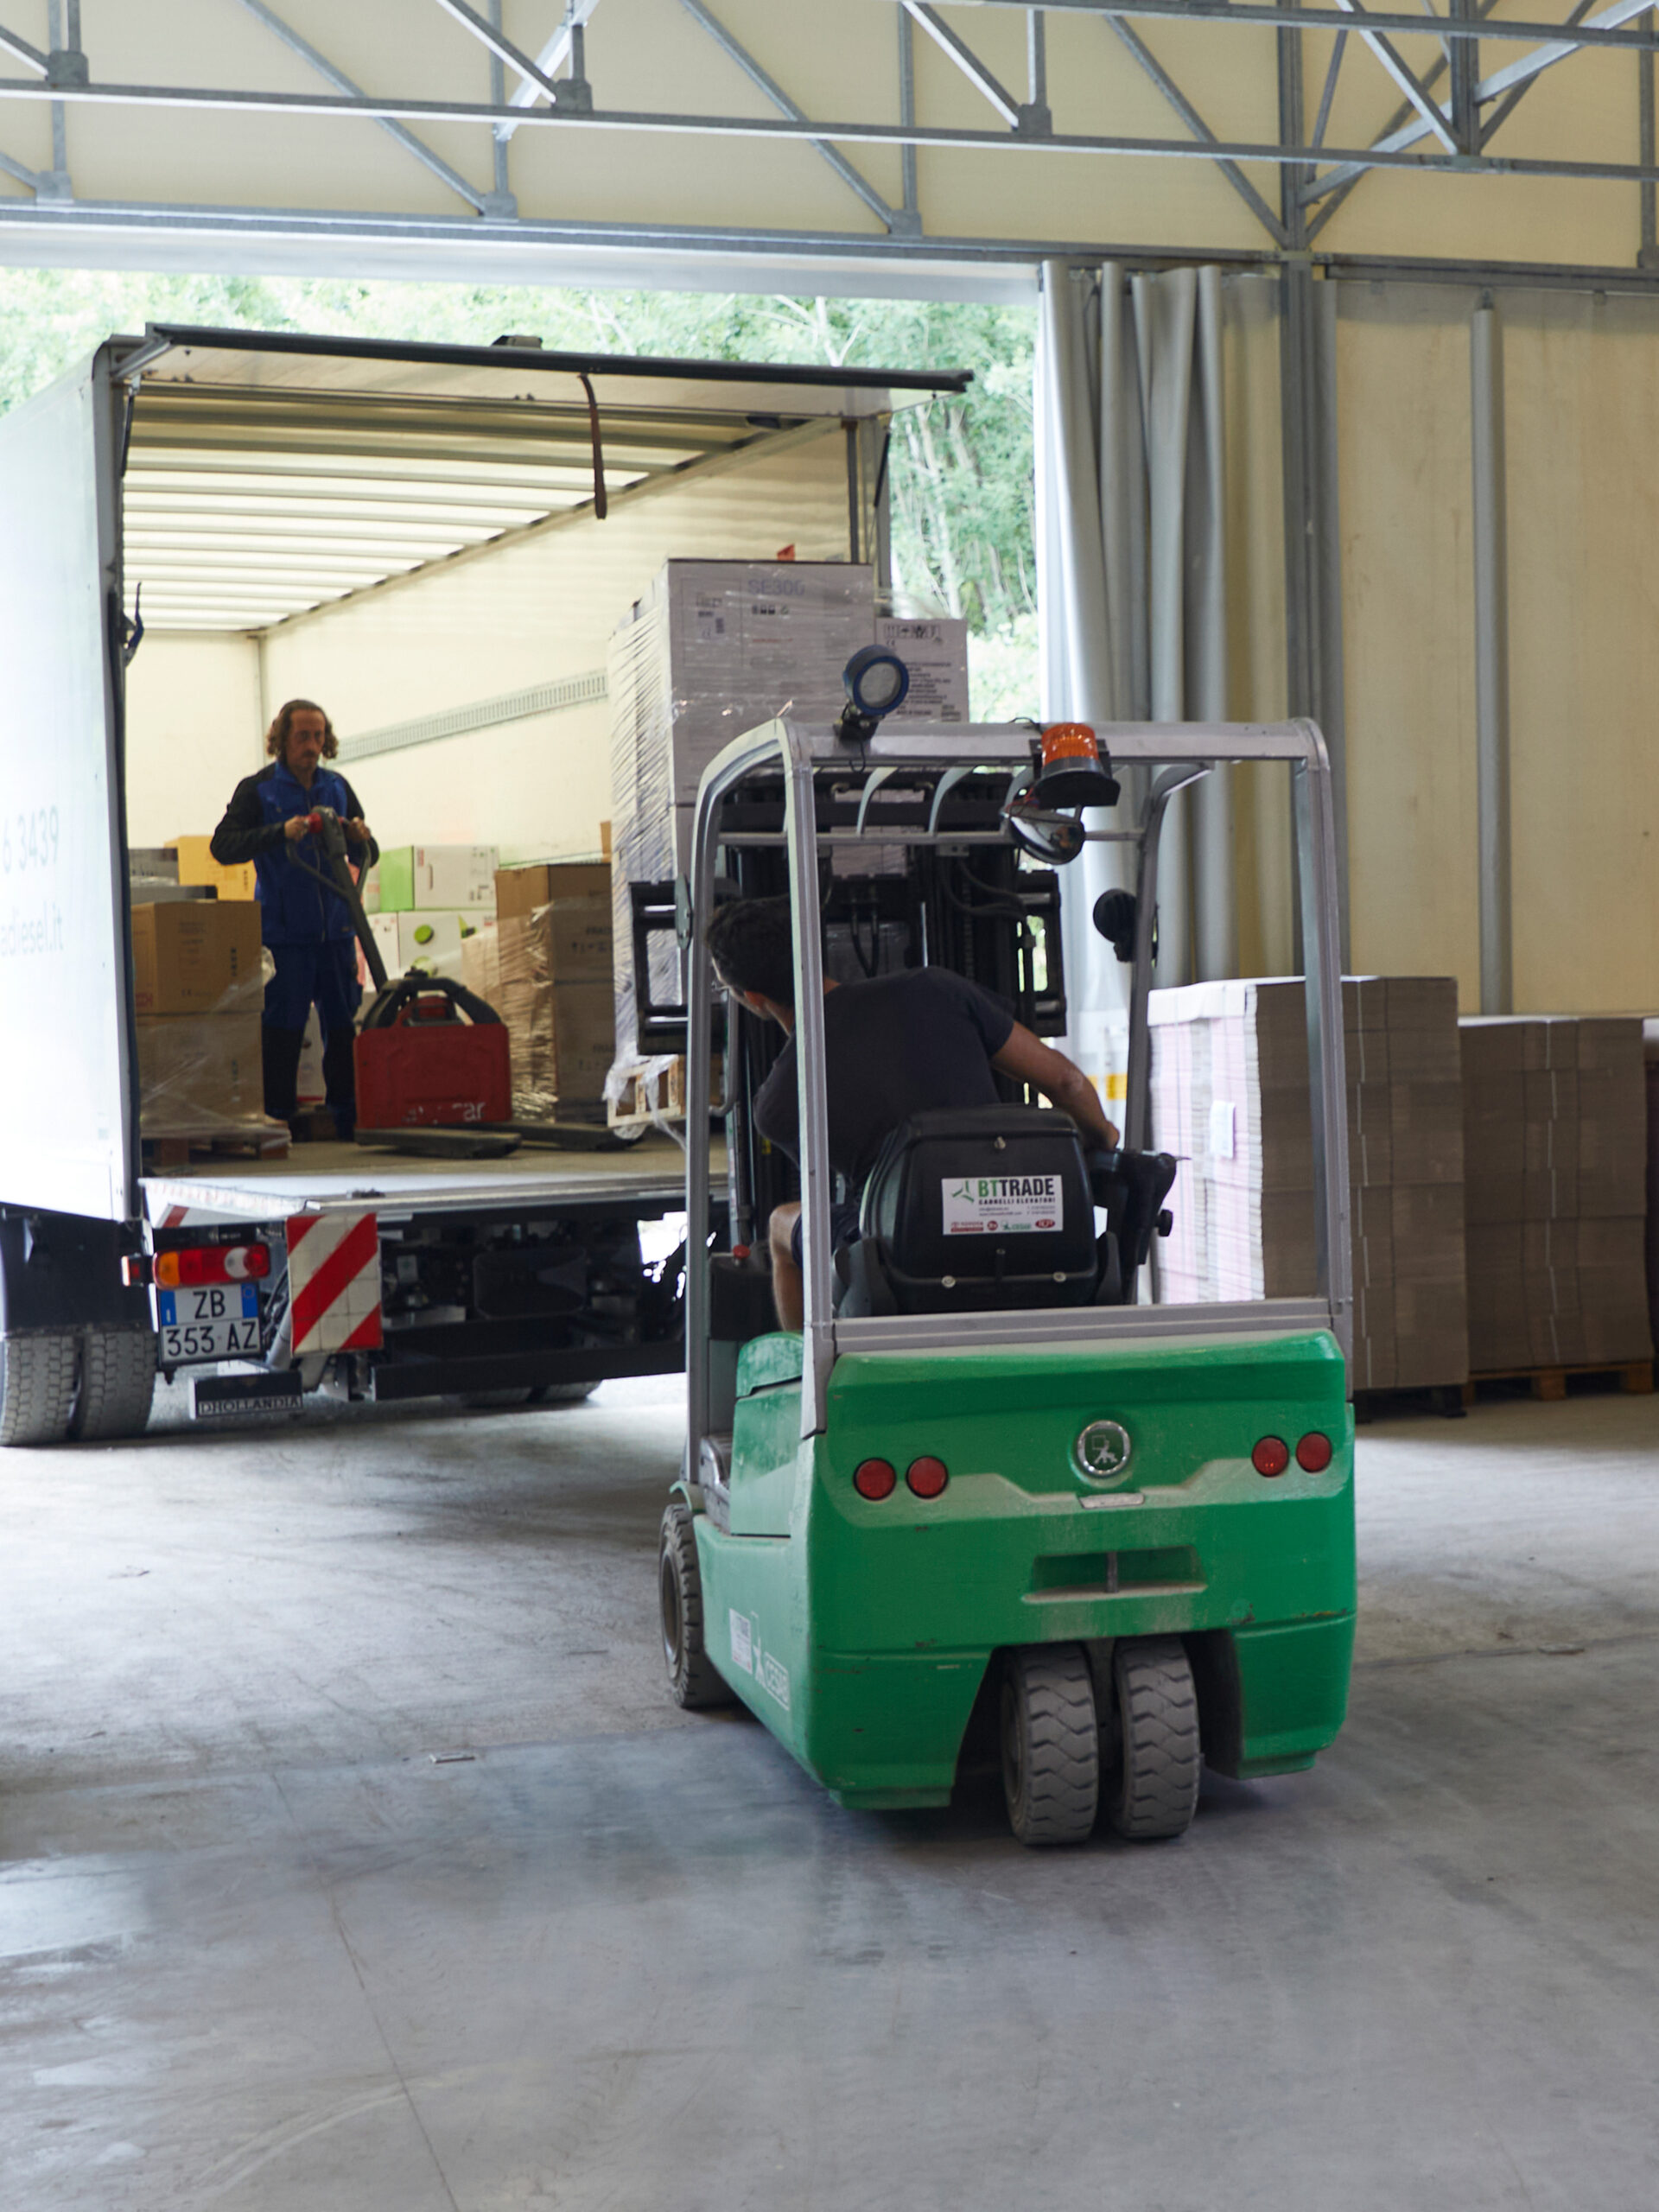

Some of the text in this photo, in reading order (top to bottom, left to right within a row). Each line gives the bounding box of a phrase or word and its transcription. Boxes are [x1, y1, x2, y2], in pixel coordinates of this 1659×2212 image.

[3, 804, 59, 874] 6 3439
[978, 1179, 1054, 1197] BTTRADE
[193, 1290, 226, 1319] ZB
[166, 1321, 257, 1356] 353 AZ
[200, 1397, 302, 1414] DHOLLANDIA
